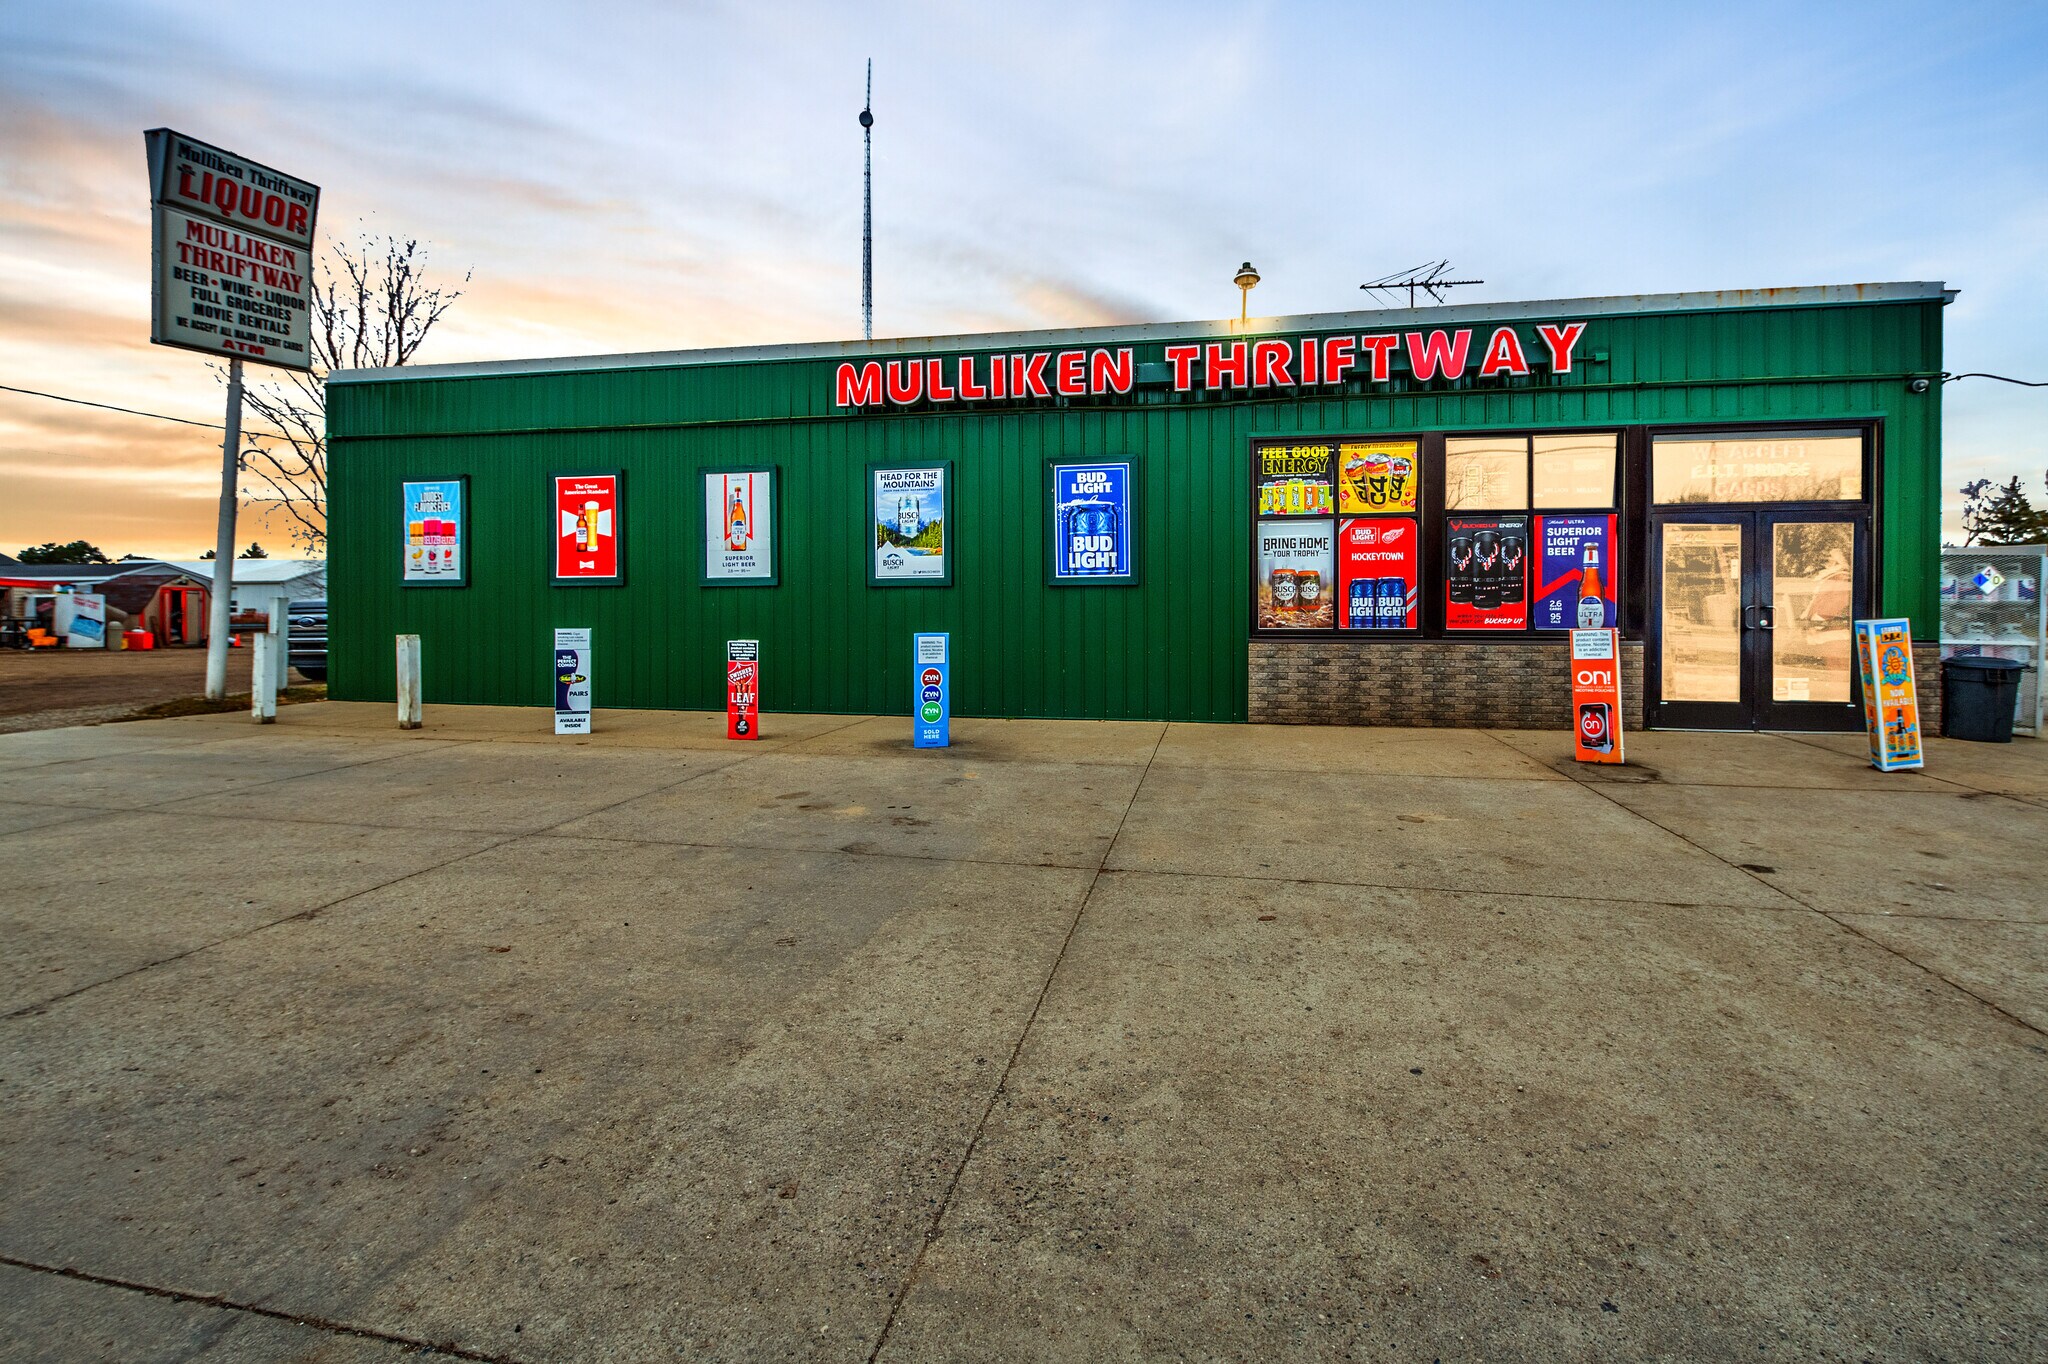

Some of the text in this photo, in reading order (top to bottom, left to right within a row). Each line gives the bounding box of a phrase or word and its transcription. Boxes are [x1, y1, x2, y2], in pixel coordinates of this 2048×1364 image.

[178, 142, 314, 206] Mulliken Thriftway
[179, 165, 308, 236] LIQUOR
[186, 219, 296, 270] MULLIKEN
[177, 241, 304, 294] THRIFTWAY
[174, 266, 305, 311] BEER WINE LIQUOR
[191, 286, 292, 321] FULL GROCERIES
[193, 302, 290, 335] MOVIE RENTALS
[176, 316, 188, 328] WE
[190, 320, 218, 334] ACCEPT
[220, 326, 233, 337] ALL
[223, 339, 265, 356] ATM
[836, 323, 1588, 407] MULLIKEN THRIFTWAY
[1262, 446, 1329, 459] FEEL GOOD
[1263, 457, 1329, 474] ENERGY
[883, 480, 935, 488] MOUNTAINS
[1077, 472, 1107, 483] BUD
[1072, 482, 1112, 494] LIGHT
[1547, 527, 1602, 536] SUPERIOR
[1073, 536, 1113, 552] BUD
[1264, 537, 1329, 551] BRING HOME
[1547, 537, 1580, 546] LIGHT
[1351, 552, 1404, 561] HOCKEYTOWN
[1547, 547, 1575, 556] BEER
[1069, 551, 1117, 568] LIGHT
[1985, 569, 1992, 577] 4
[1993, 576, 2000, 585] 0
[1378, 597, 1403, 607] BUD
[1349, 606, 1373, 616] LIGH
[1375, 606, 1406, 616] LIGHT
[1577, 670, 1611, 685] on!
[731, 692, 755, 703] LEAF
[1883, 697, 1913, 707] AVAILABLE
[1585, 720, 1599, 729] on
